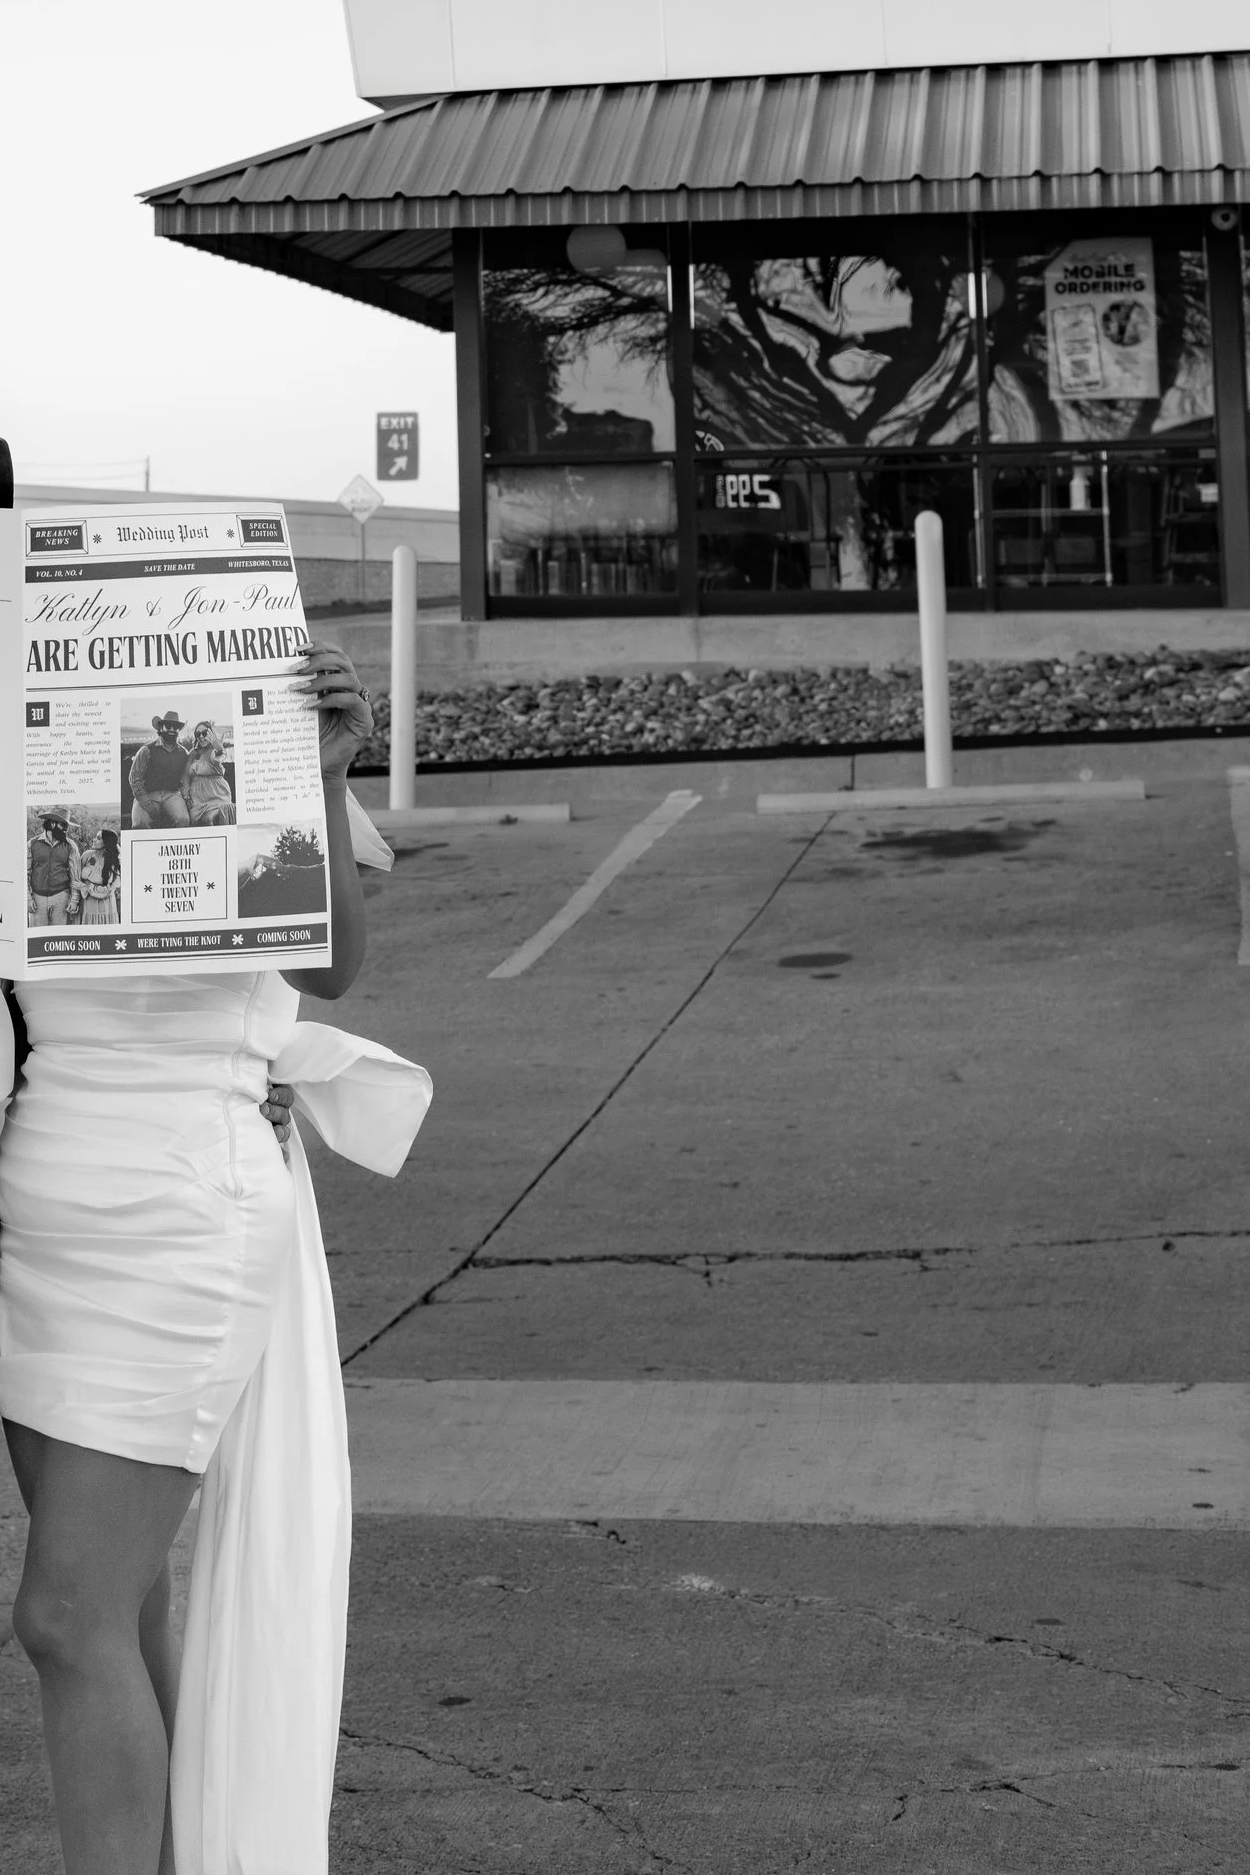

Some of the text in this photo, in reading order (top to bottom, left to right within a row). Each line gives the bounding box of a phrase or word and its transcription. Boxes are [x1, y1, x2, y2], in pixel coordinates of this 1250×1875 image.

[1064, 263, 1135, 279] MOBILE
[1055, 280, 1146, 295] ORDERING
[380, 416, 414, 429] EXIT
[387, 433, 409, 450] 41
[249, 522, 277, 530] SPECIAL
[36, 529, 78, 538] BREAKING
[117, 525, 209, 542] Wedding Post
[45, 537, 70, 545] NEWS
[272, 559, 289, 567] TEXAS
[25, 581, 300, 636] Katlyn & Jon-Paul
[27, 627, 308, 672] ARE GETTING MARRIED
[158, 844, 200, 856] JANUARY
[168, 858, 191, 870] 18TH
[161, 872, 198, 884] TWENTY
[161, 886, 198, 898] TWENTY
[165, 900, 194, 913] SEVEN
[137, 935, 221, 948] WERE TYING THE KNOT
[257, 930, 311, 943] COMING SOON
[44, 940, 101, 952] COMING SOON
